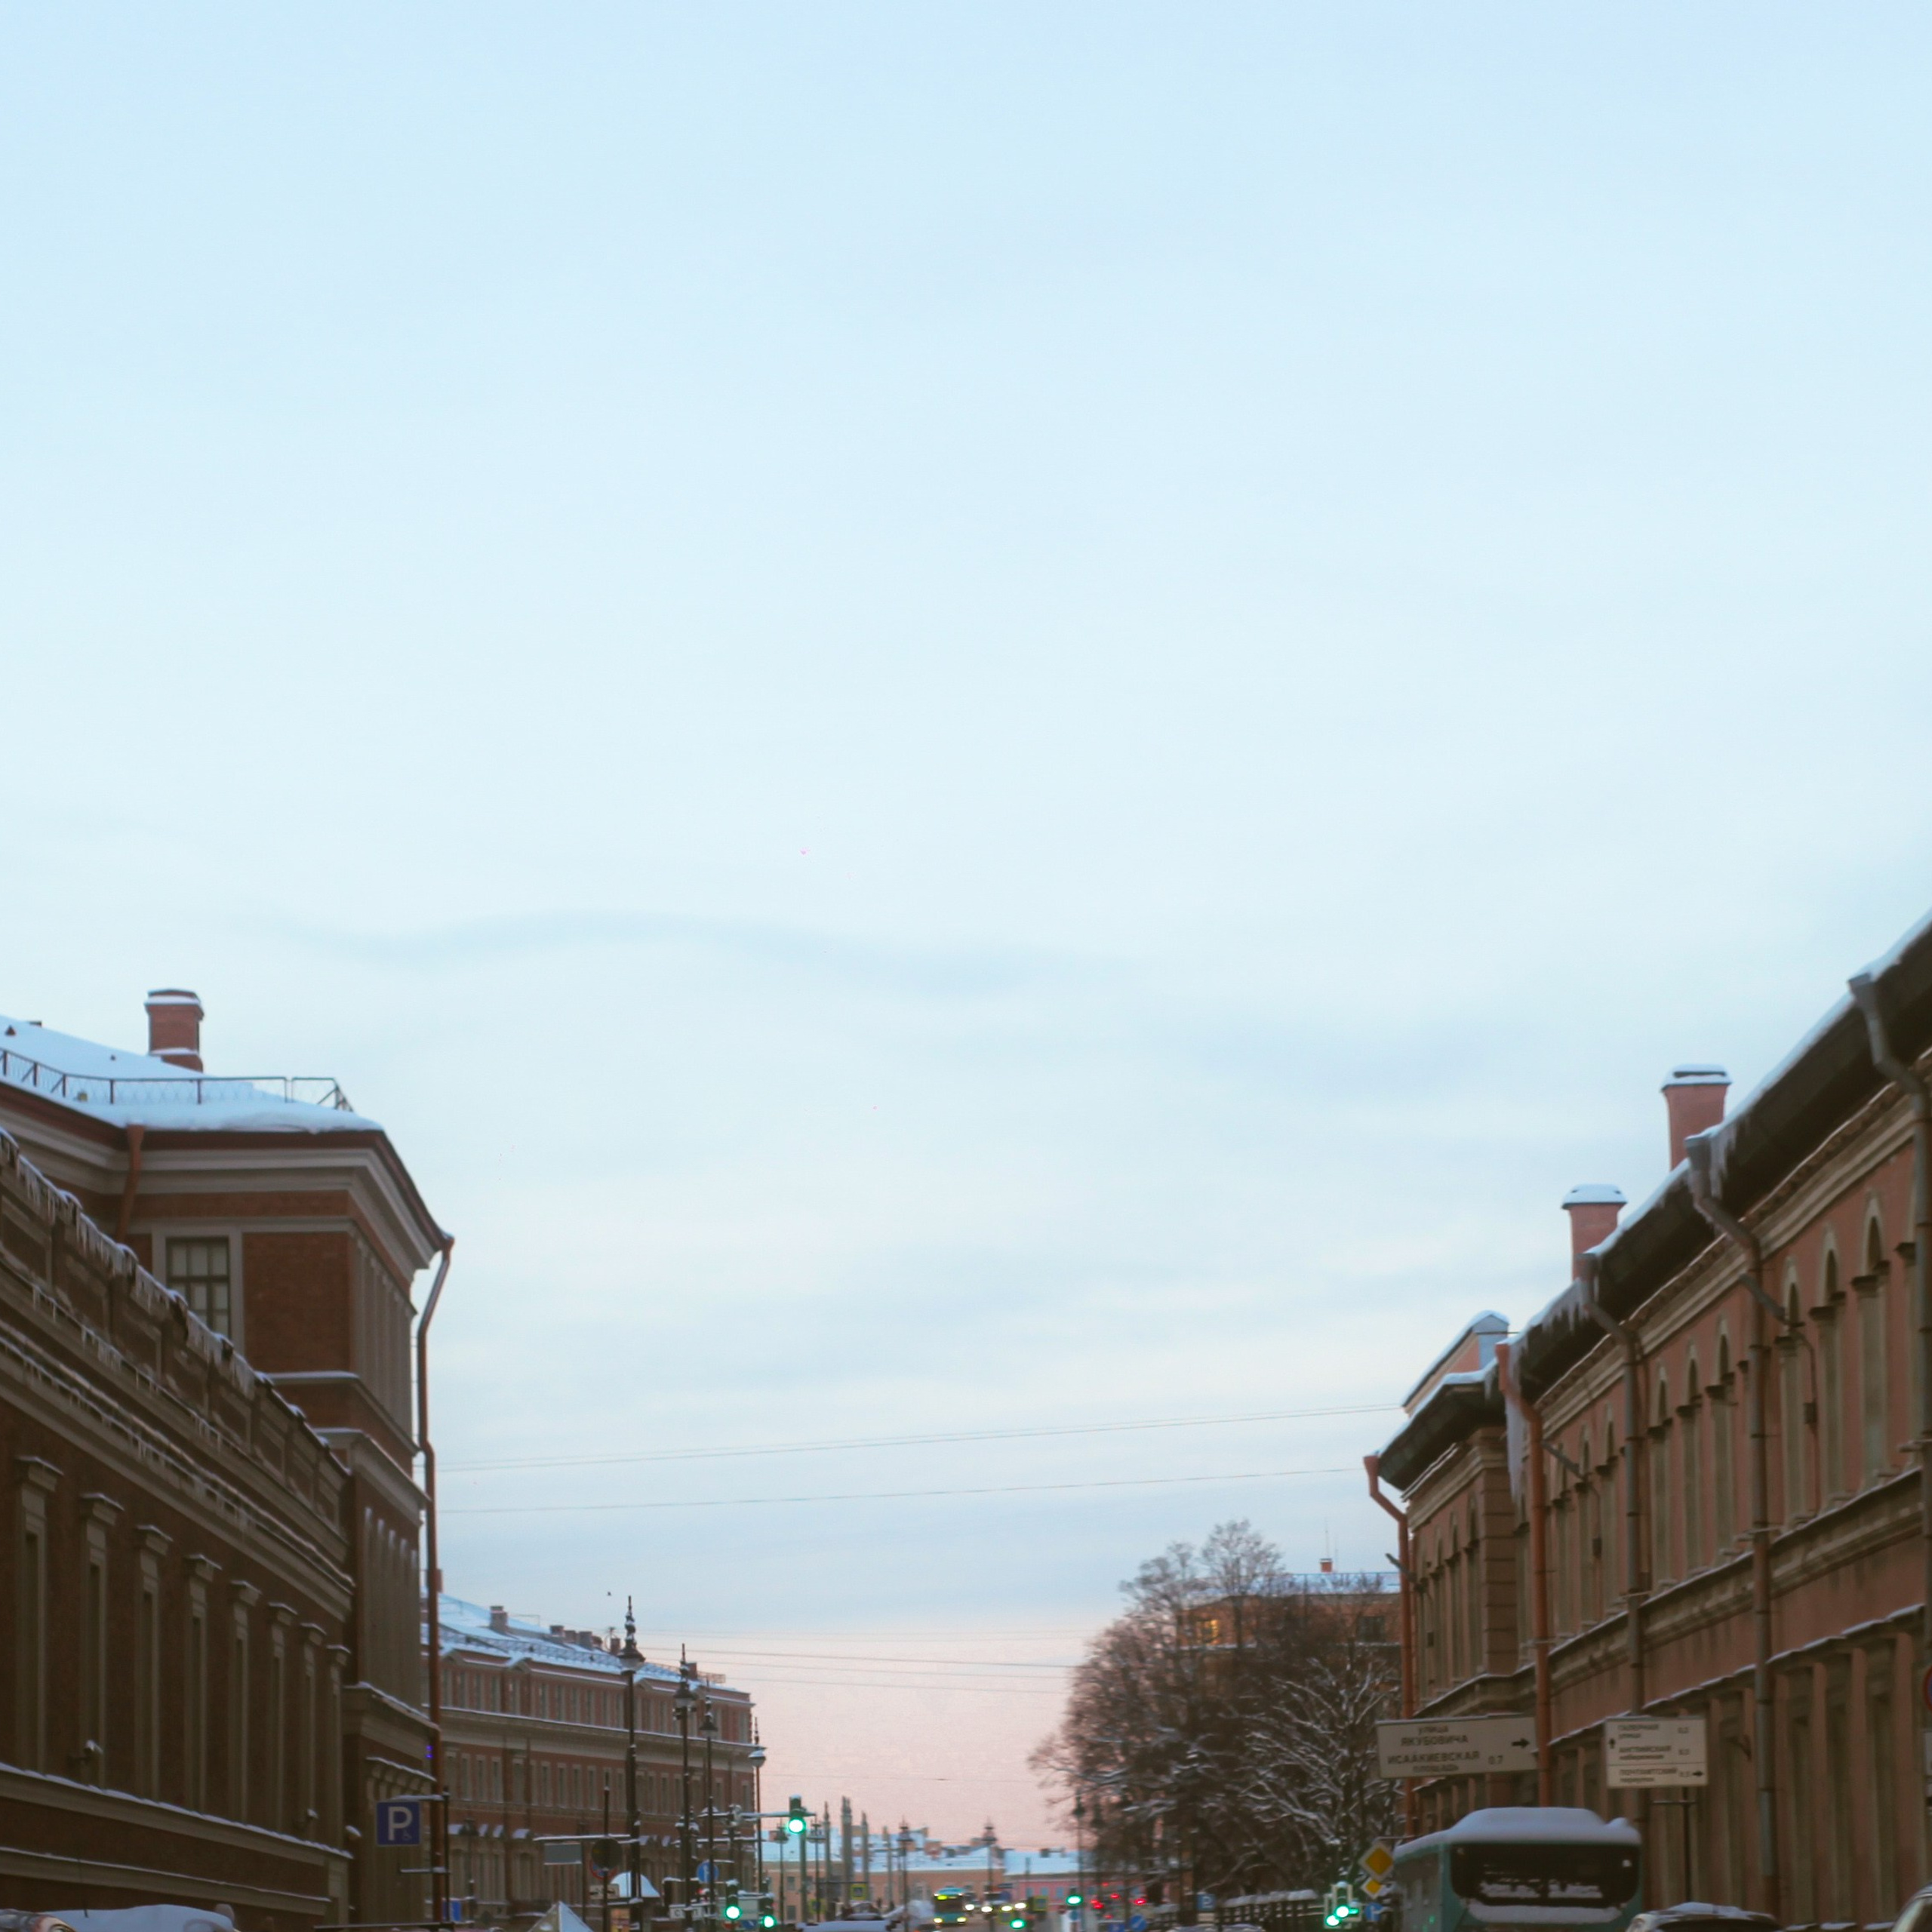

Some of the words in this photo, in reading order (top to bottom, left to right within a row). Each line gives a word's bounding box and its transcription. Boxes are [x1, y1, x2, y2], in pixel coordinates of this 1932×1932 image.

[1400, 1735, 1469, 1746] ЯКУБОВИЧА
[1387, 1750, 1481, 1764] ИСААКИЕВСКАЯ
[388, 1806, 413, 1841] P
